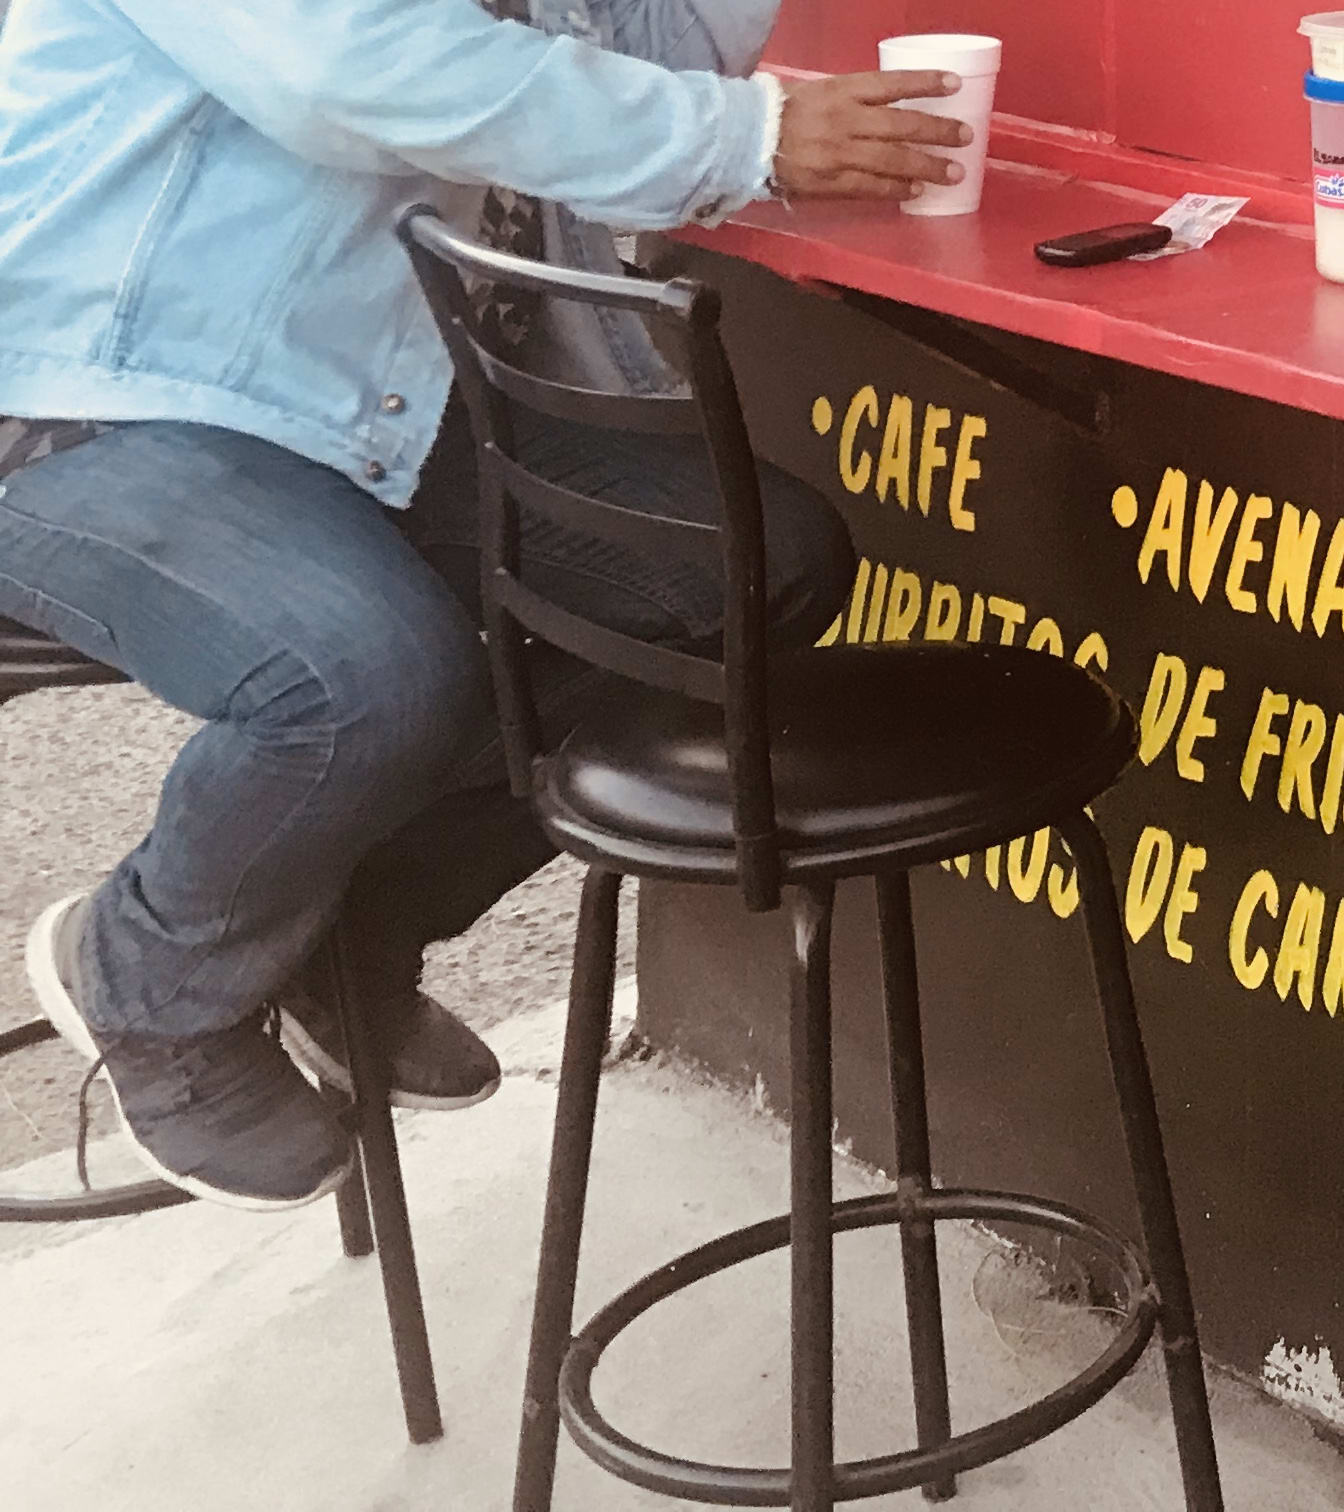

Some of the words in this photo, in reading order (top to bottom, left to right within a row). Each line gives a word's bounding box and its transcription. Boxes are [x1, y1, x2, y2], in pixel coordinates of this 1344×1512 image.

[1185, 197, 1209, 209] 50
[838, 383, 988, 532] CAFE
[1140, 652, 1225, 782] DE
[1126, 826, 1204, 964] DE
